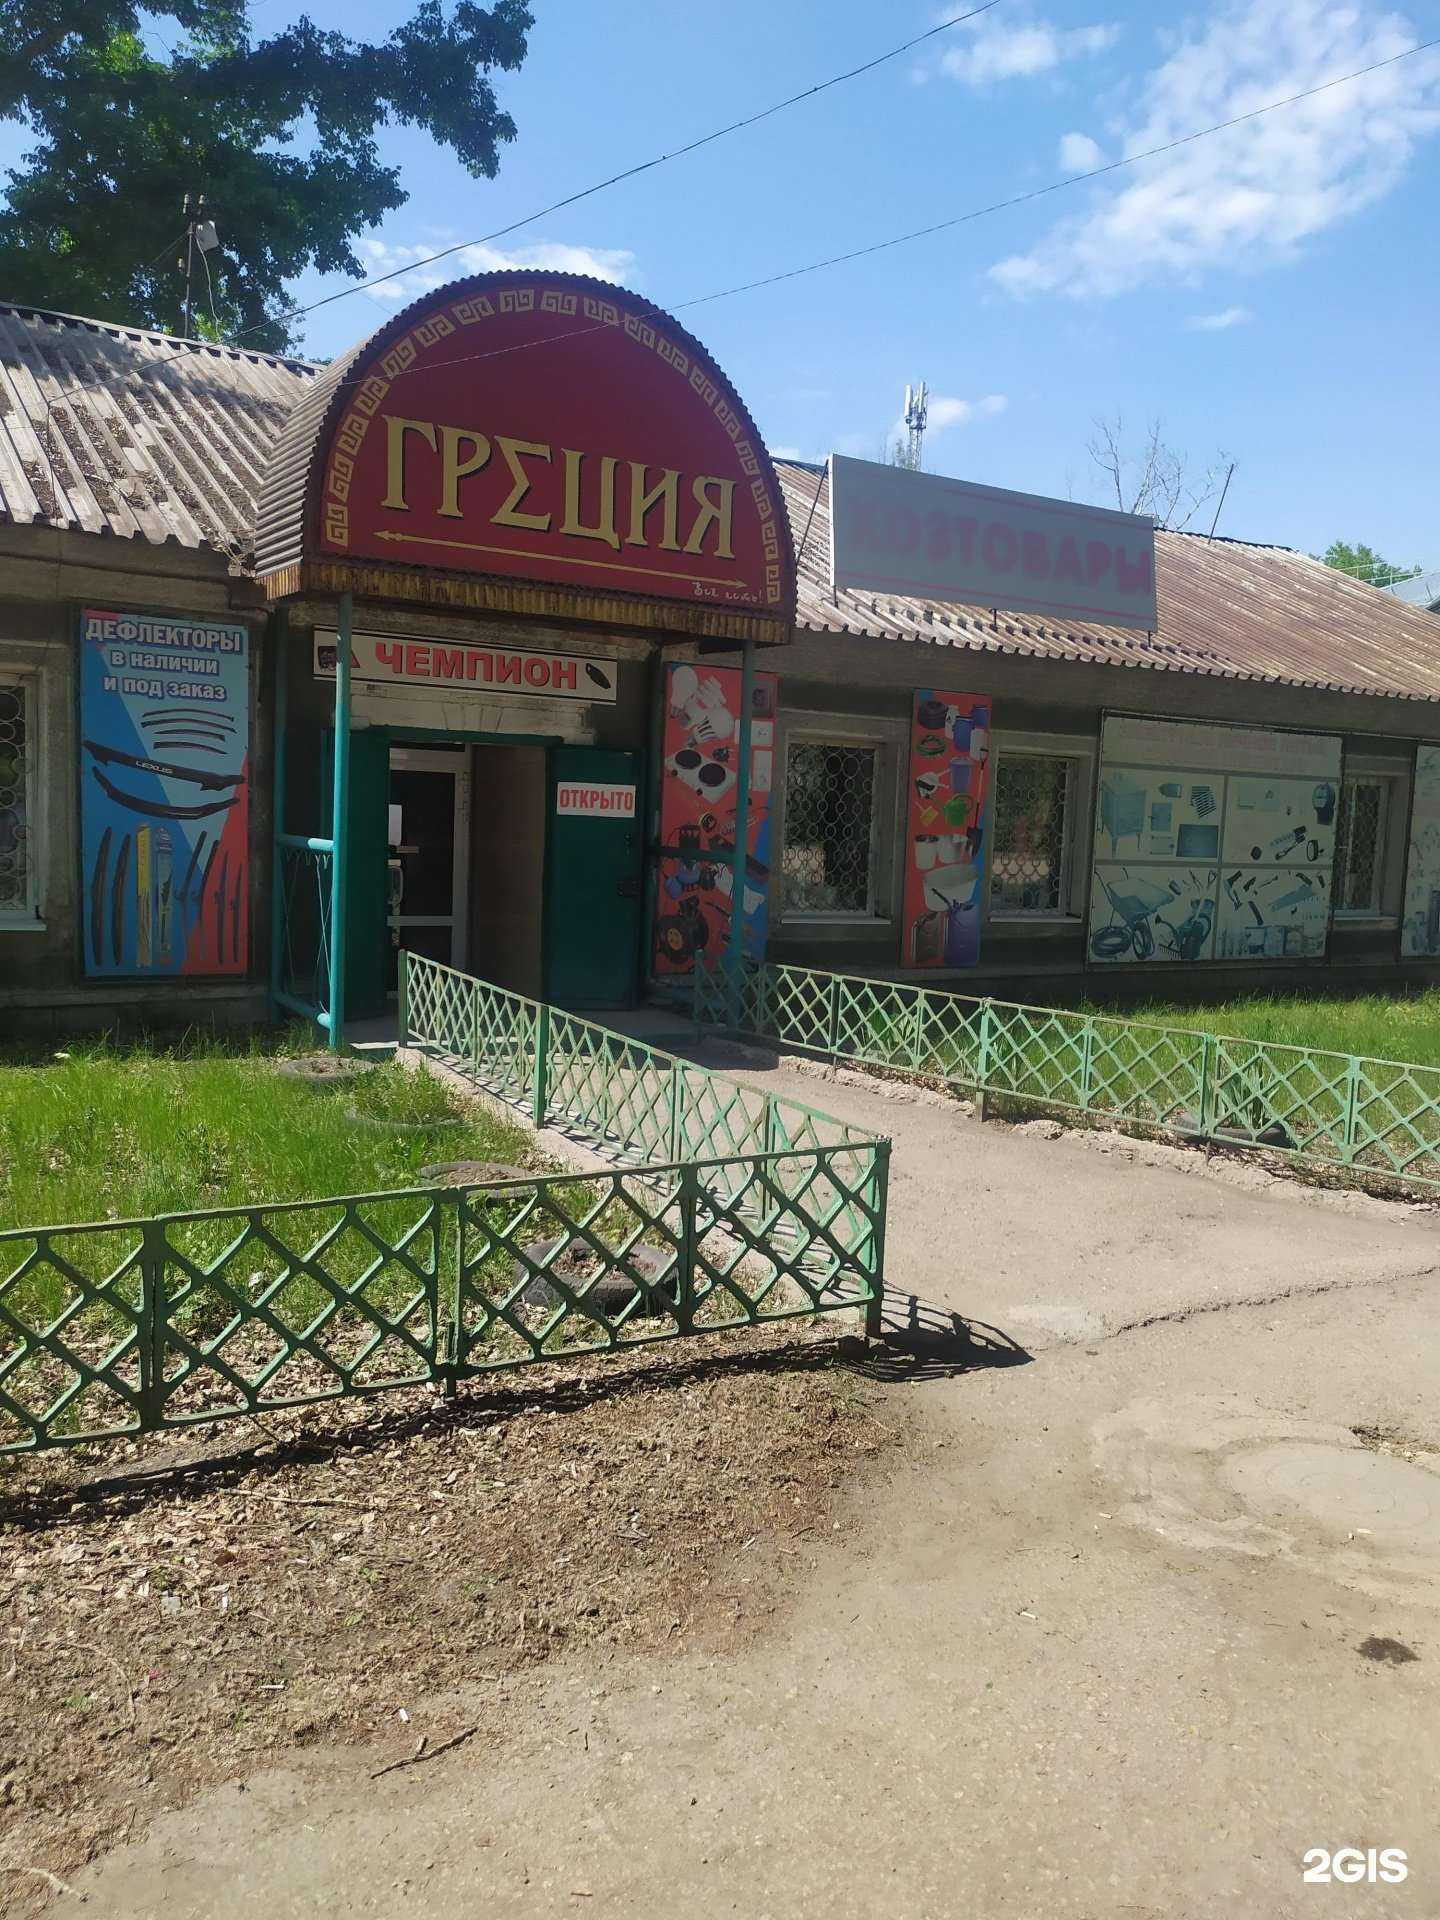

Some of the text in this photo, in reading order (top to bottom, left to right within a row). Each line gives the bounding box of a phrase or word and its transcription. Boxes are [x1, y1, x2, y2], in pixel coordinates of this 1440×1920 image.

[85, 617, 242, 653] ДЕФЛЕКТОРЫ
[111, 650, 219, 675] в наличии
[375, 642, 577, 690] ЧЕМПИОН
[103, 676, 227, 701] и под заказ
[559, 788, 634, 811] ОТКРЫТО
